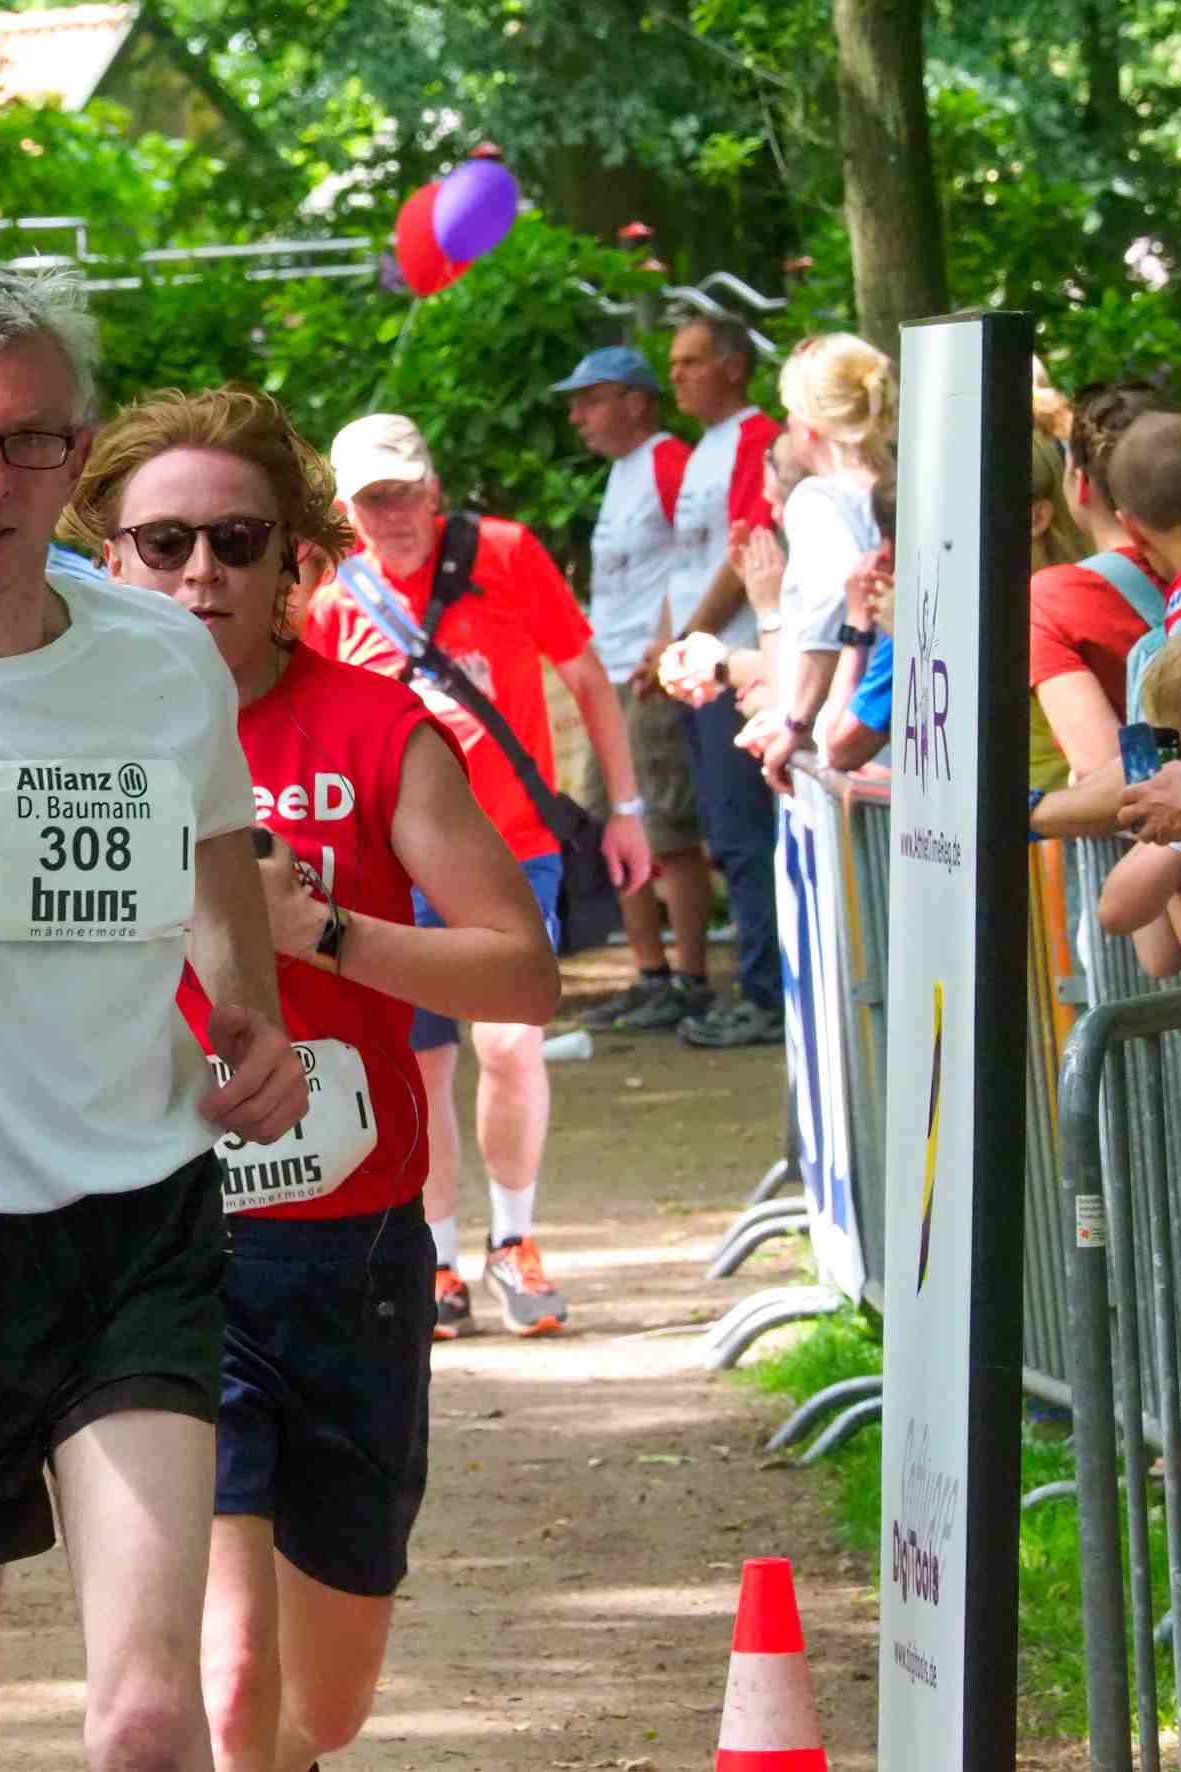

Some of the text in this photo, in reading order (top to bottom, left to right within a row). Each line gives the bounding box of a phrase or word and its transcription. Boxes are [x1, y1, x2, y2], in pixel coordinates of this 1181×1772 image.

[17, 767, 113, 791] Allianz
[17, 796, 151, 819] D. Baumann
[39, 826, 132, 871] 308
[32, 877, 137, 922] bruns
[222, 1154, 322, 1196] bruns
